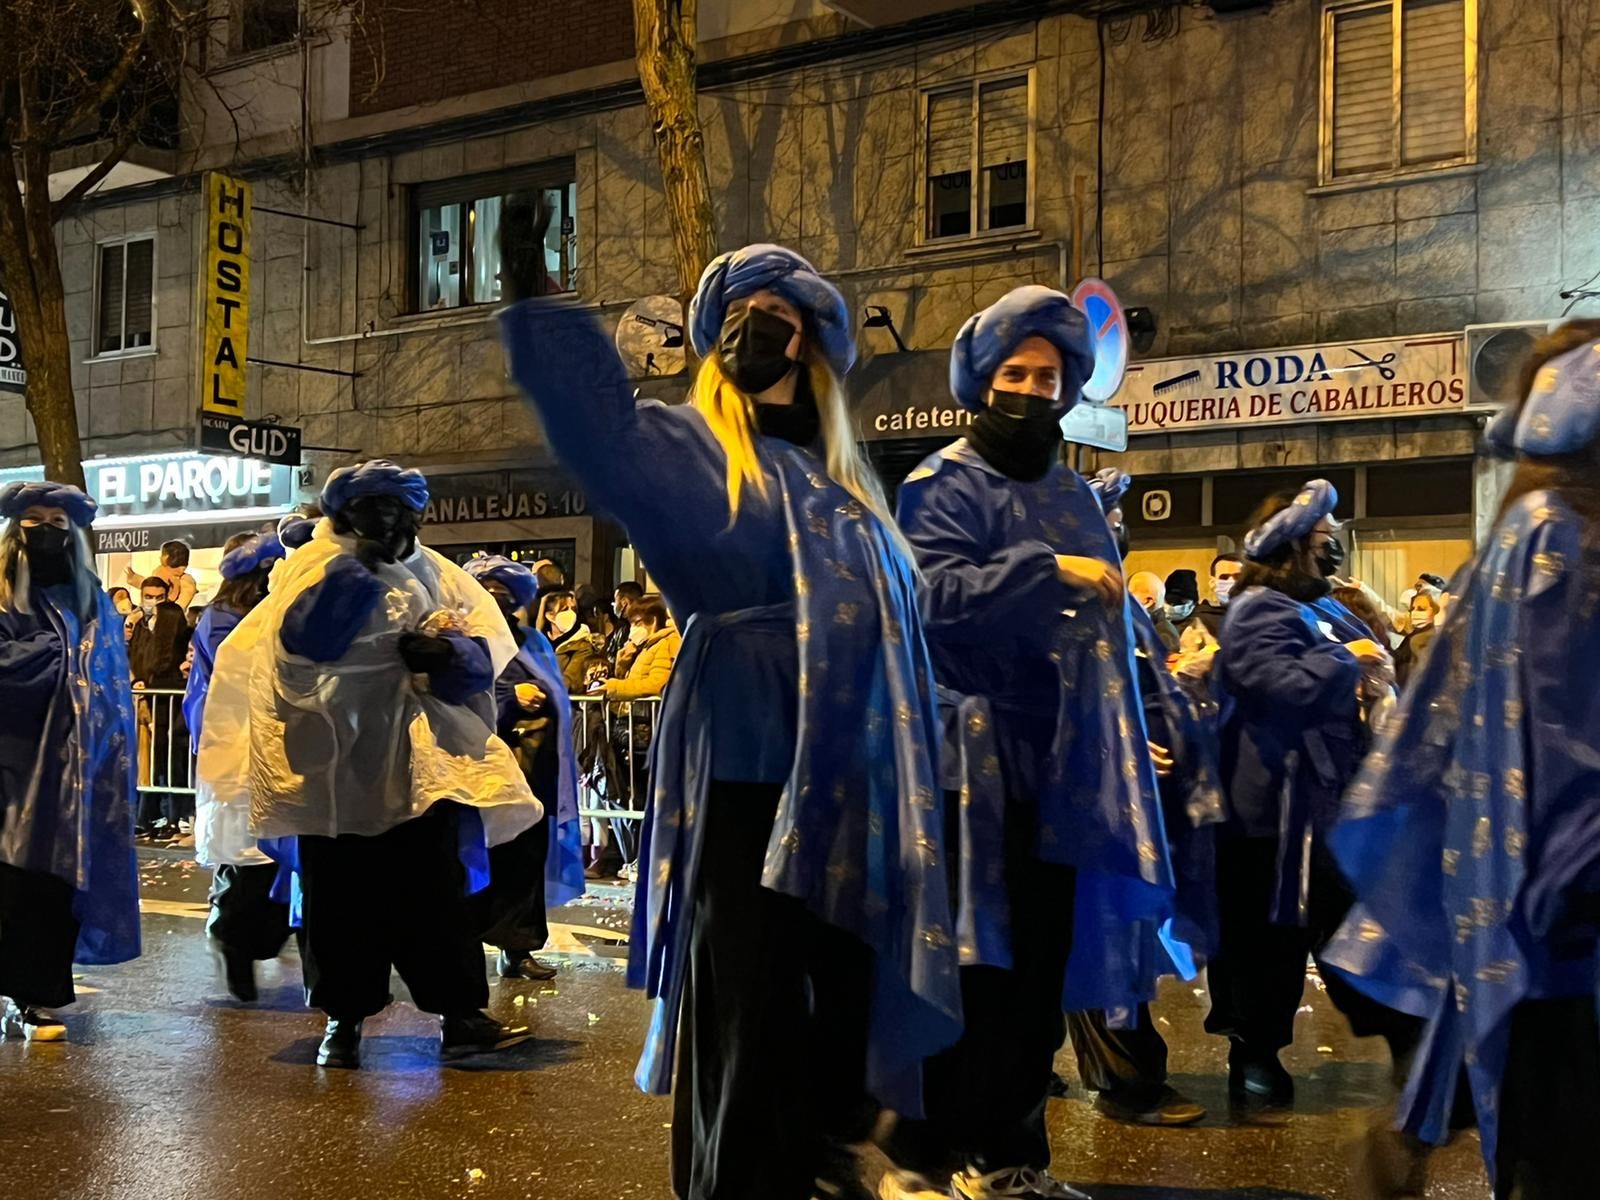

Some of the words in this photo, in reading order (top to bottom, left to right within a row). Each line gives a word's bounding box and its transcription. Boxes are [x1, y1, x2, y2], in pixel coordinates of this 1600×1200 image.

[212, 183, 244, 408] HOSTAL
[1216, 352, 1333, 389] RODA
[1249, 393, 1282, 417] DE
[1290, 378, 1464, 414] CABALLEROS
[874, 406, 979, 432] cafeteri
[98, 466, 135, 505] EL
[139, 456, 272, 503] PARQUE
[417, 491, 547, 523] ANALEJAS
[99, 530, 149, 551] PARQUE
